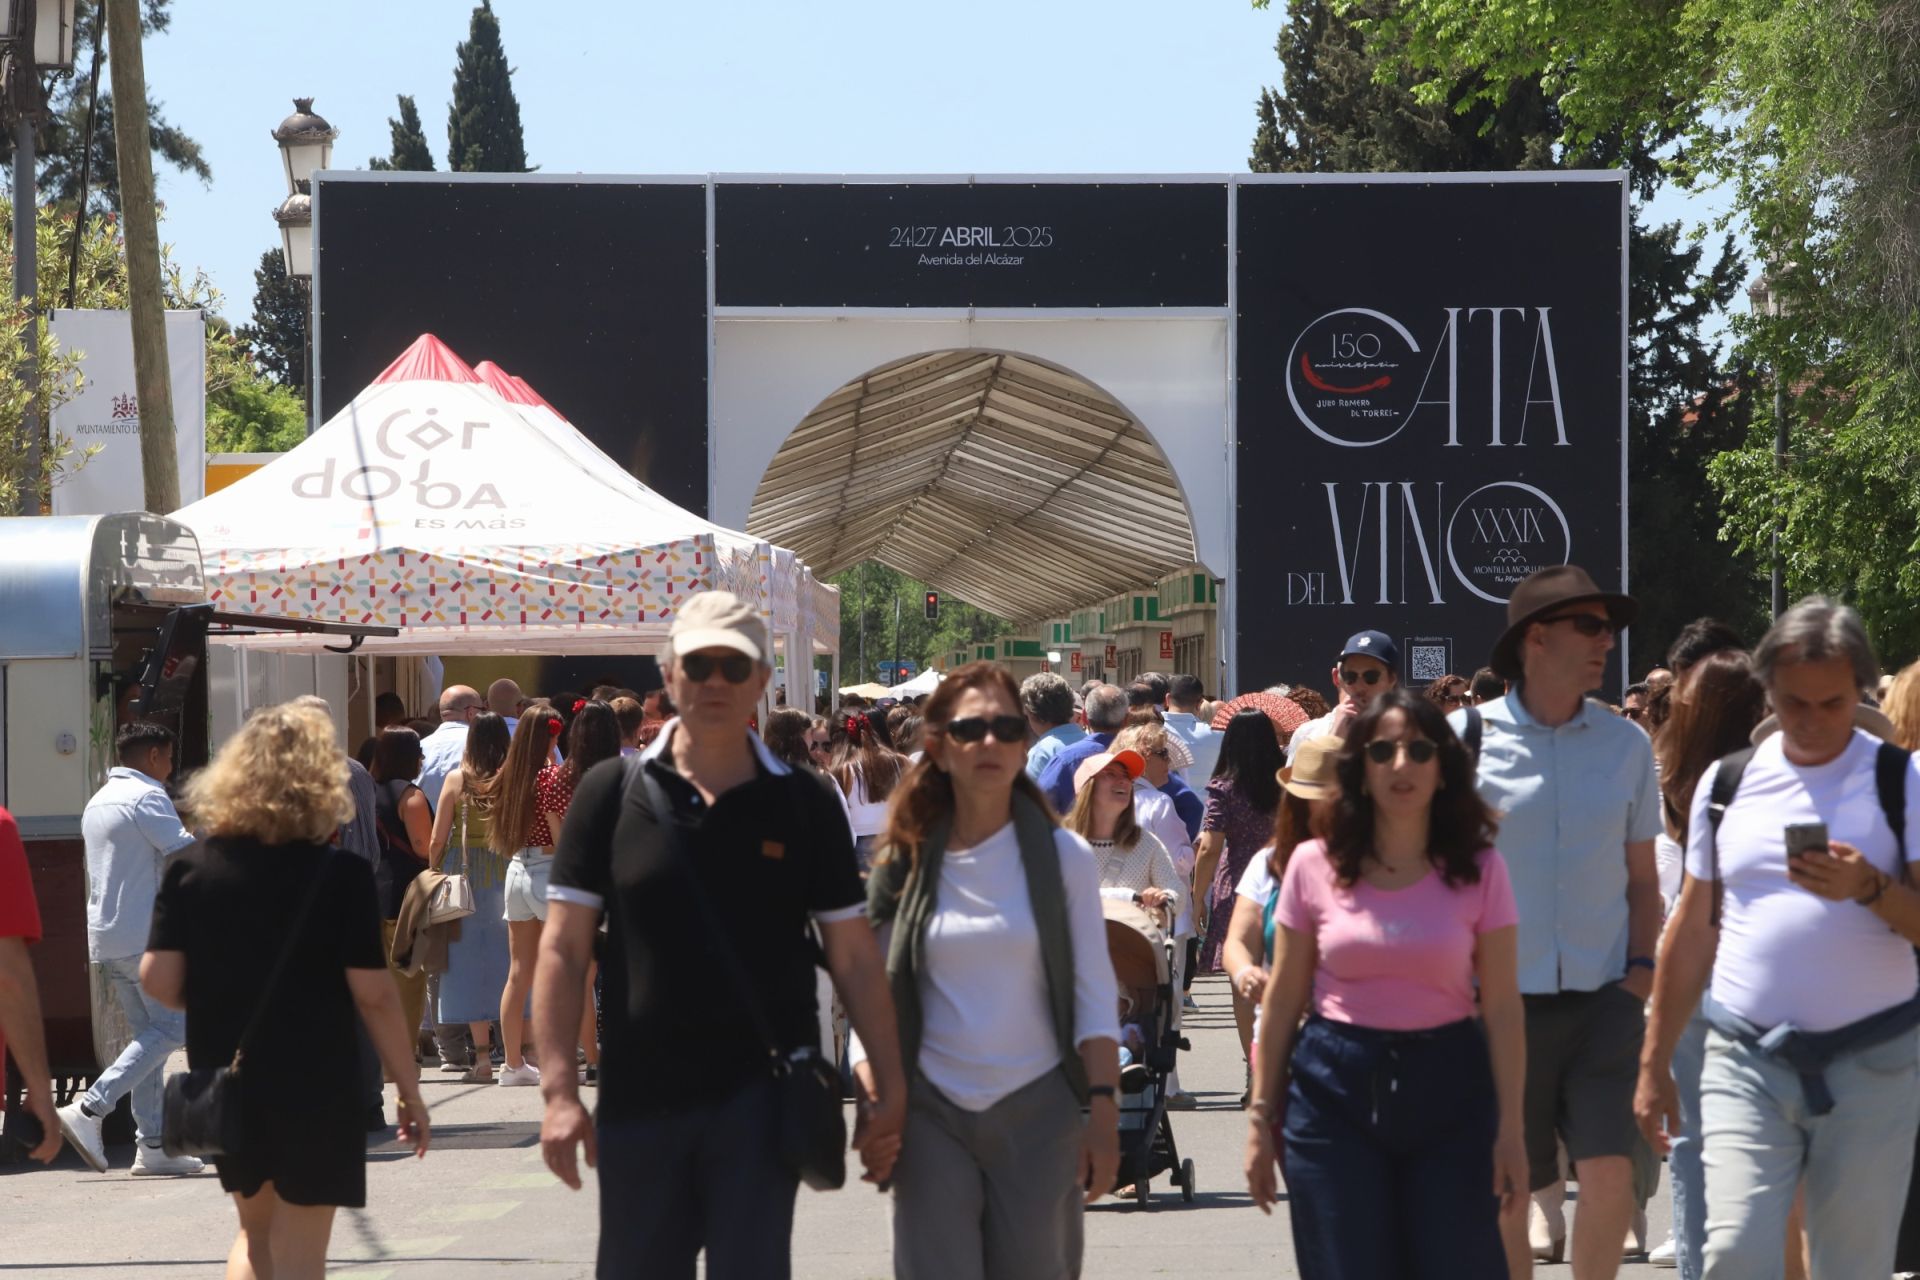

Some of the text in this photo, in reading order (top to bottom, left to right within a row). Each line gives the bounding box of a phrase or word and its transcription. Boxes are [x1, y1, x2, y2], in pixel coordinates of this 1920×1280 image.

[939, 226, 1001, 247] ABRIL
[1002, 226, 1053, 247] 2025
[918, 252, 1024, 265] Avenida del Alcázar
[1331, 333, 1381, 358] 150
[1286, 307, 1571, 447] CATA
[1338, 399, 1371, 407] ROMERO
[76, 424, 131, 435] AYUNTAMIENTO
[1471, 508, 1545, 543] XXXIX
[1287, 481, 1571, 605] DEL VINO
[1474, 565, 1511, 574] MONTILLA
